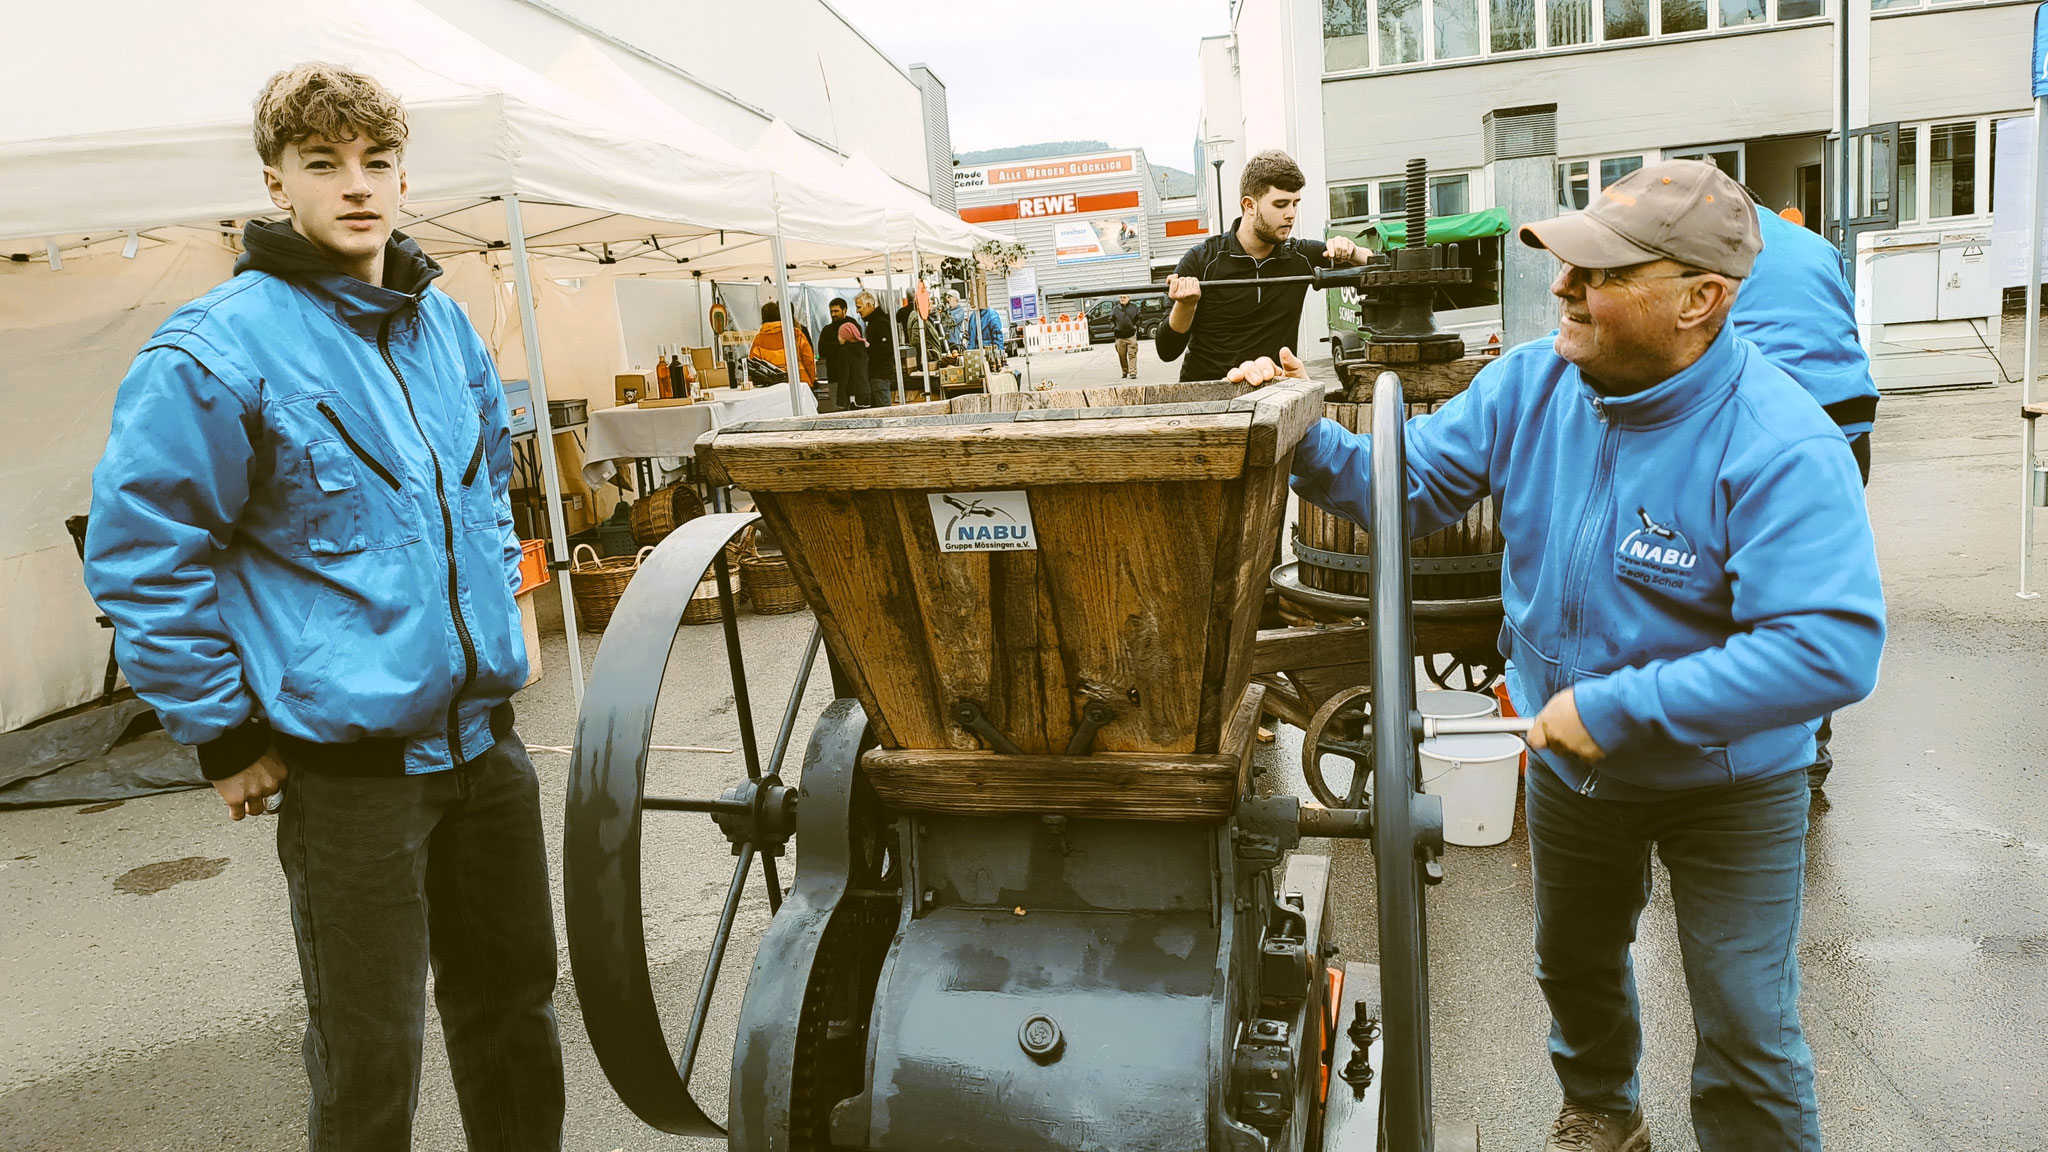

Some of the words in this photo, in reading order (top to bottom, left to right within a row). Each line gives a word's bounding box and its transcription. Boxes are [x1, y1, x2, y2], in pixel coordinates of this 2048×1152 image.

[954, 171, 982, 180] Mode
[954, 179, 984, 188] Center
[1020, 194, 1075, 216] REWE
[958, 525, 1027, 541] NABU
[945, 543, 973, 551] Gruppe
[974, 541, 1015, 550] Mössingen
[1016, 541, 1030, 549] e.V.
[1630, 541, 1696, 568] NABU
[1619, 566, 1651, 582] Georg
